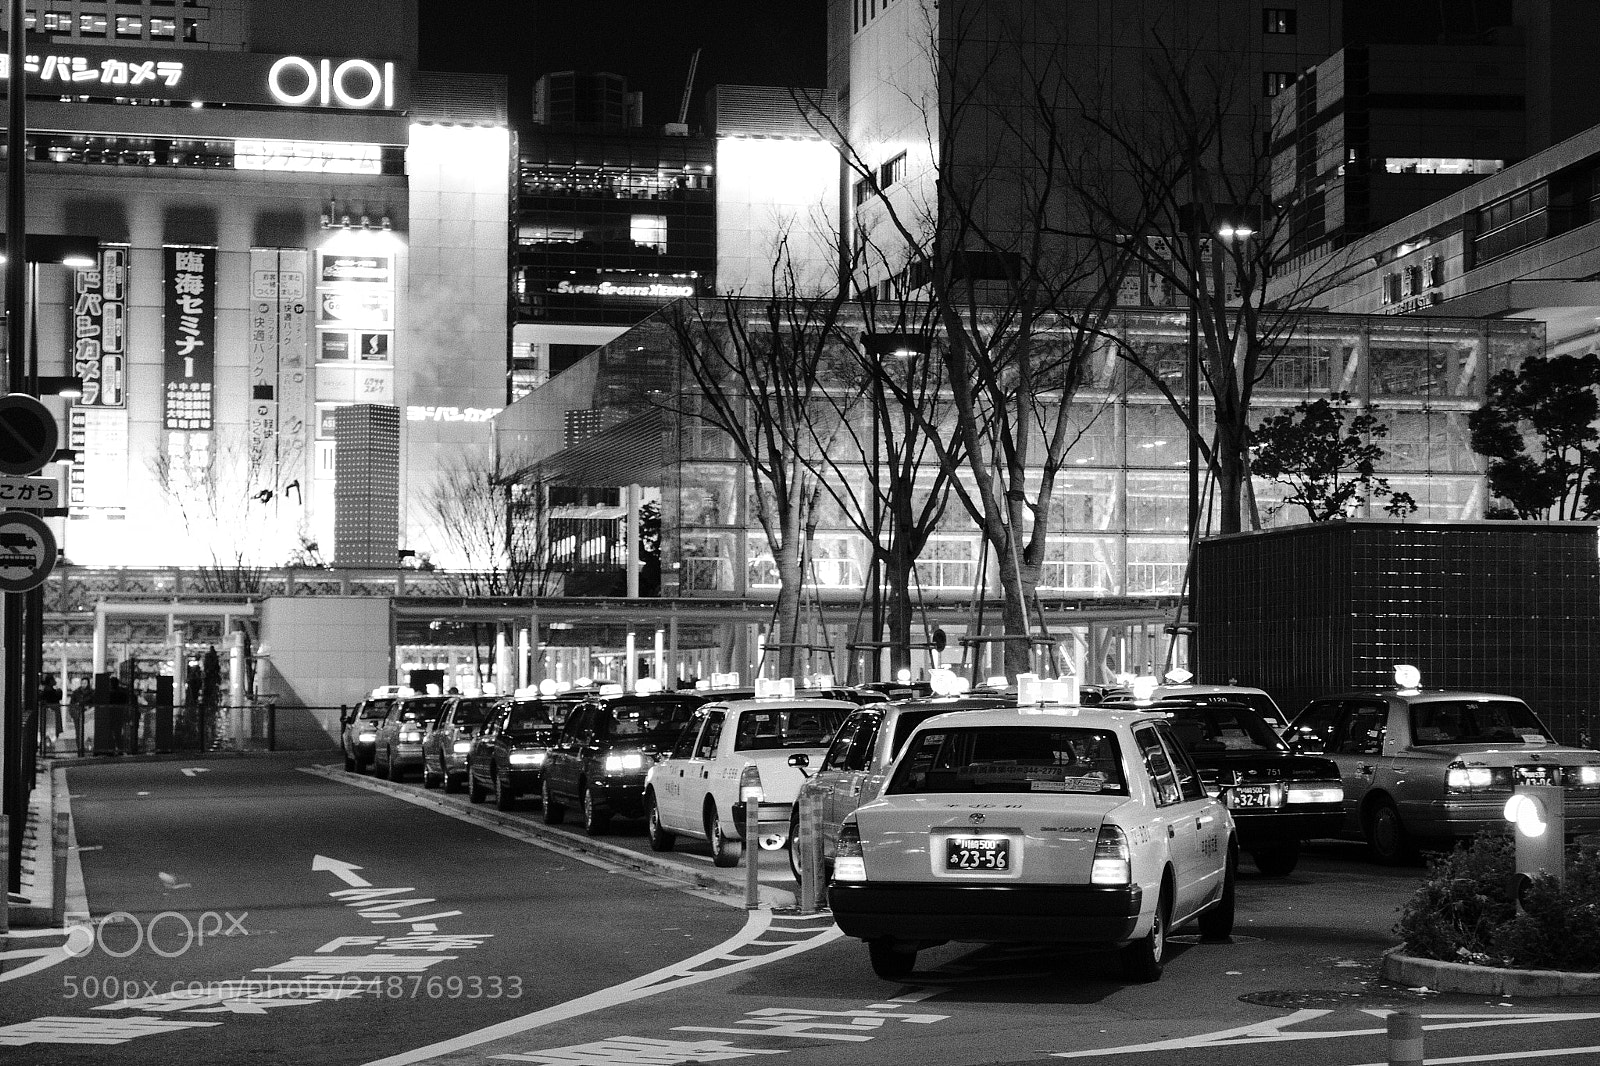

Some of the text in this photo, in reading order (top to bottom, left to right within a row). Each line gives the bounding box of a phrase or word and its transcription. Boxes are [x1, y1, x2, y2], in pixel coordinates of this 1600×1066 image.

[175, 251, 204, 378] 臨海セミナー
[0, 484, 53, 500] こから
[1240, 793, 1270, 806] 32-47
[959, 850, 1006, 868] 23-56
